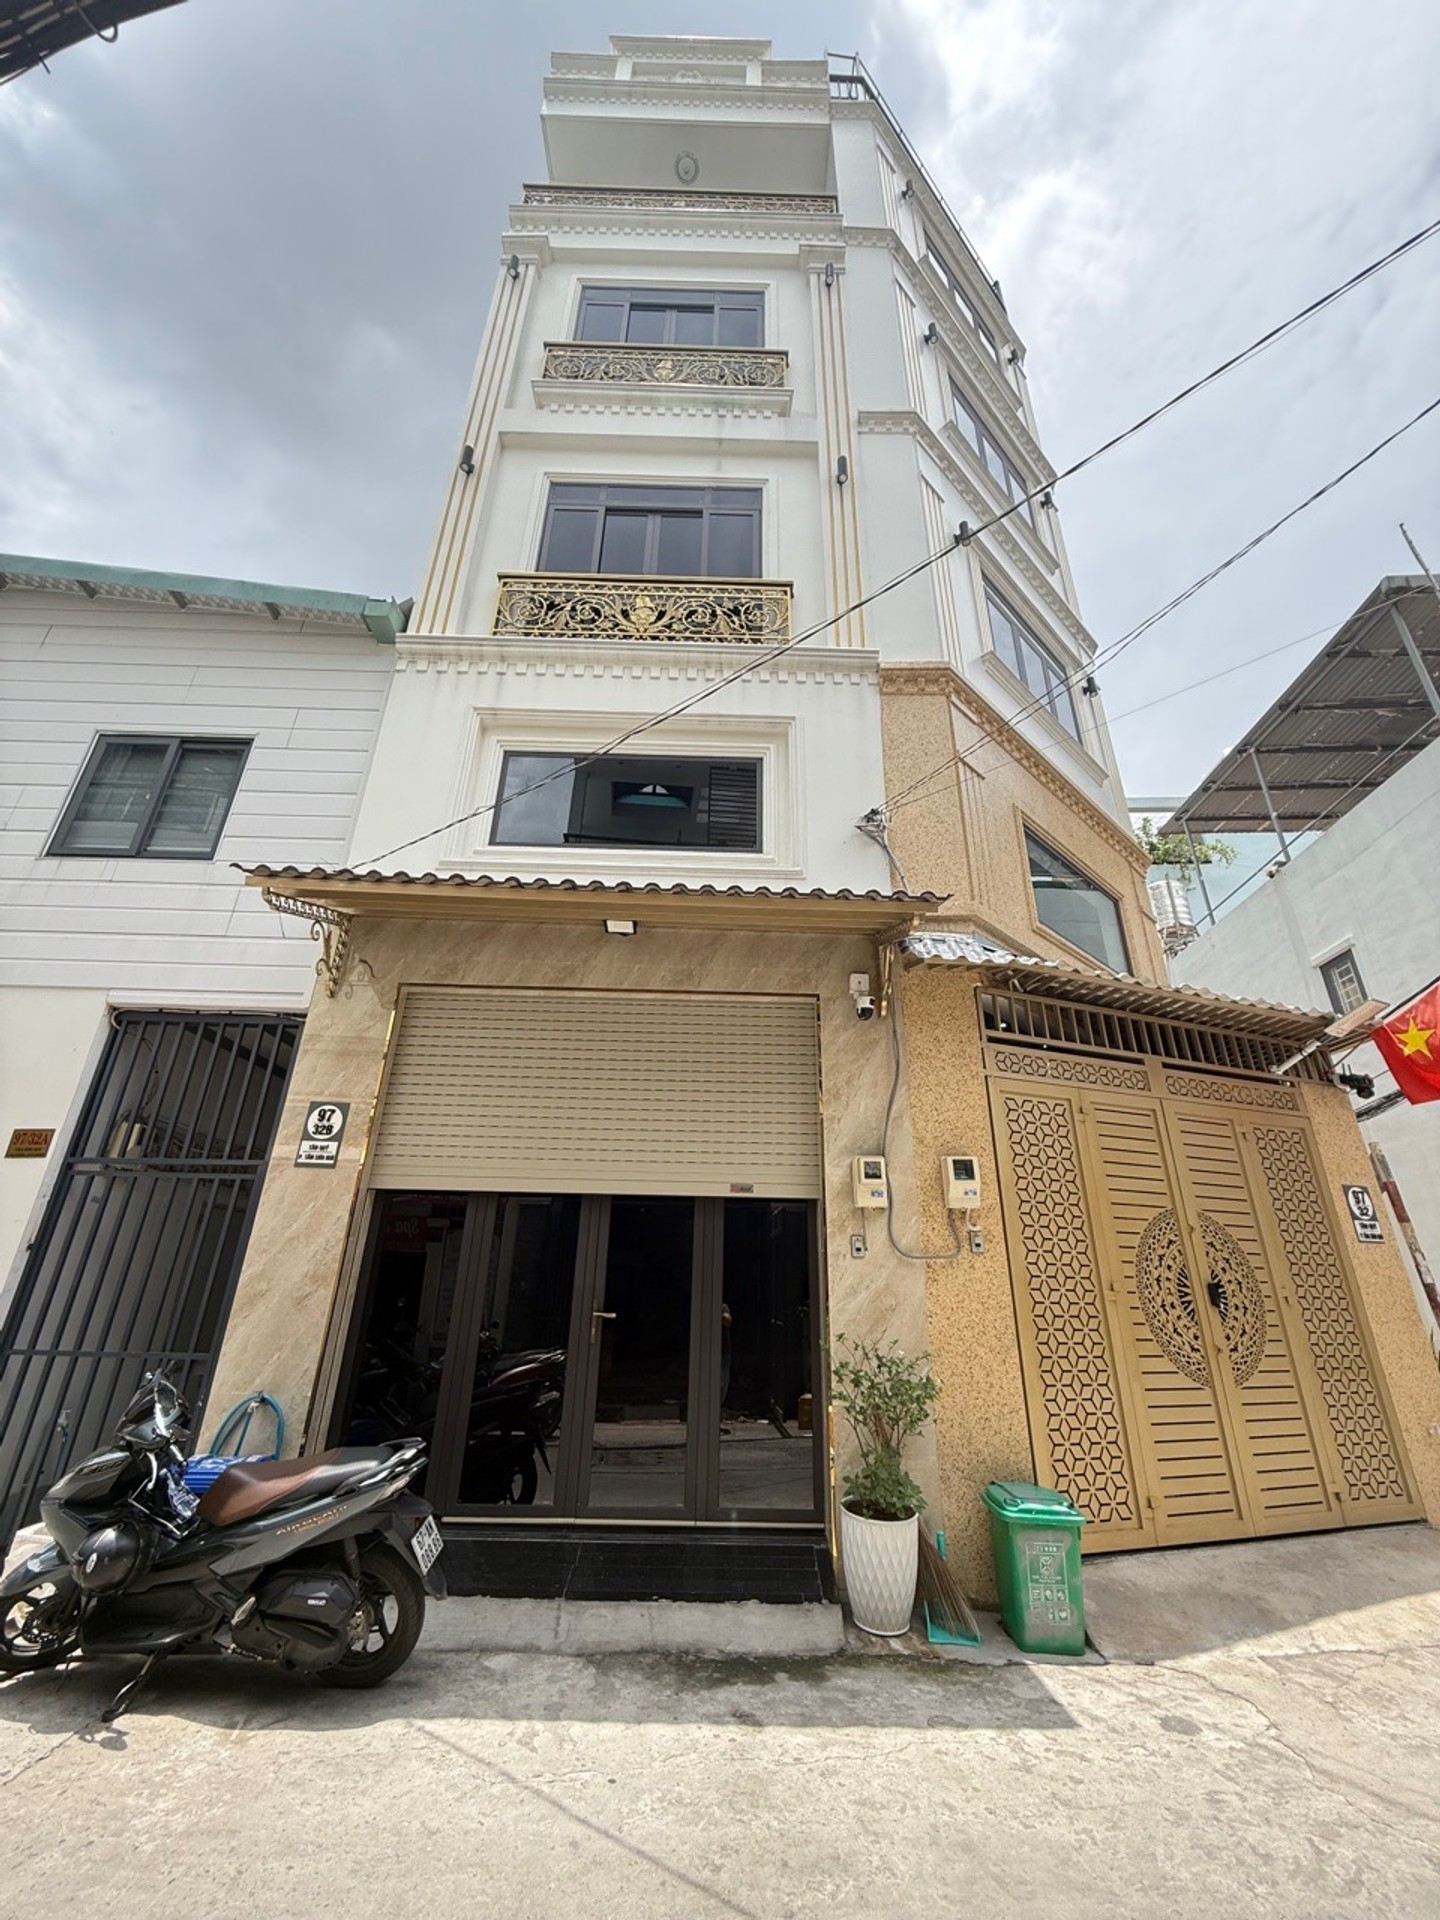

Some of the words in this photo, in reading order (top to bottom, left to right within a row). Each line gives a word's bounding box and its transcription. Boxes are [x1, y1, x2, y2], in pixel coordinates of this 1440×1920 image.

[317, 1108, 336, 1122] 97
[312, 1124, 334, 1136] 32B
[1351, 1189, 1365, 1205] 97
[1357, 1206, 1370, 1217] 32
